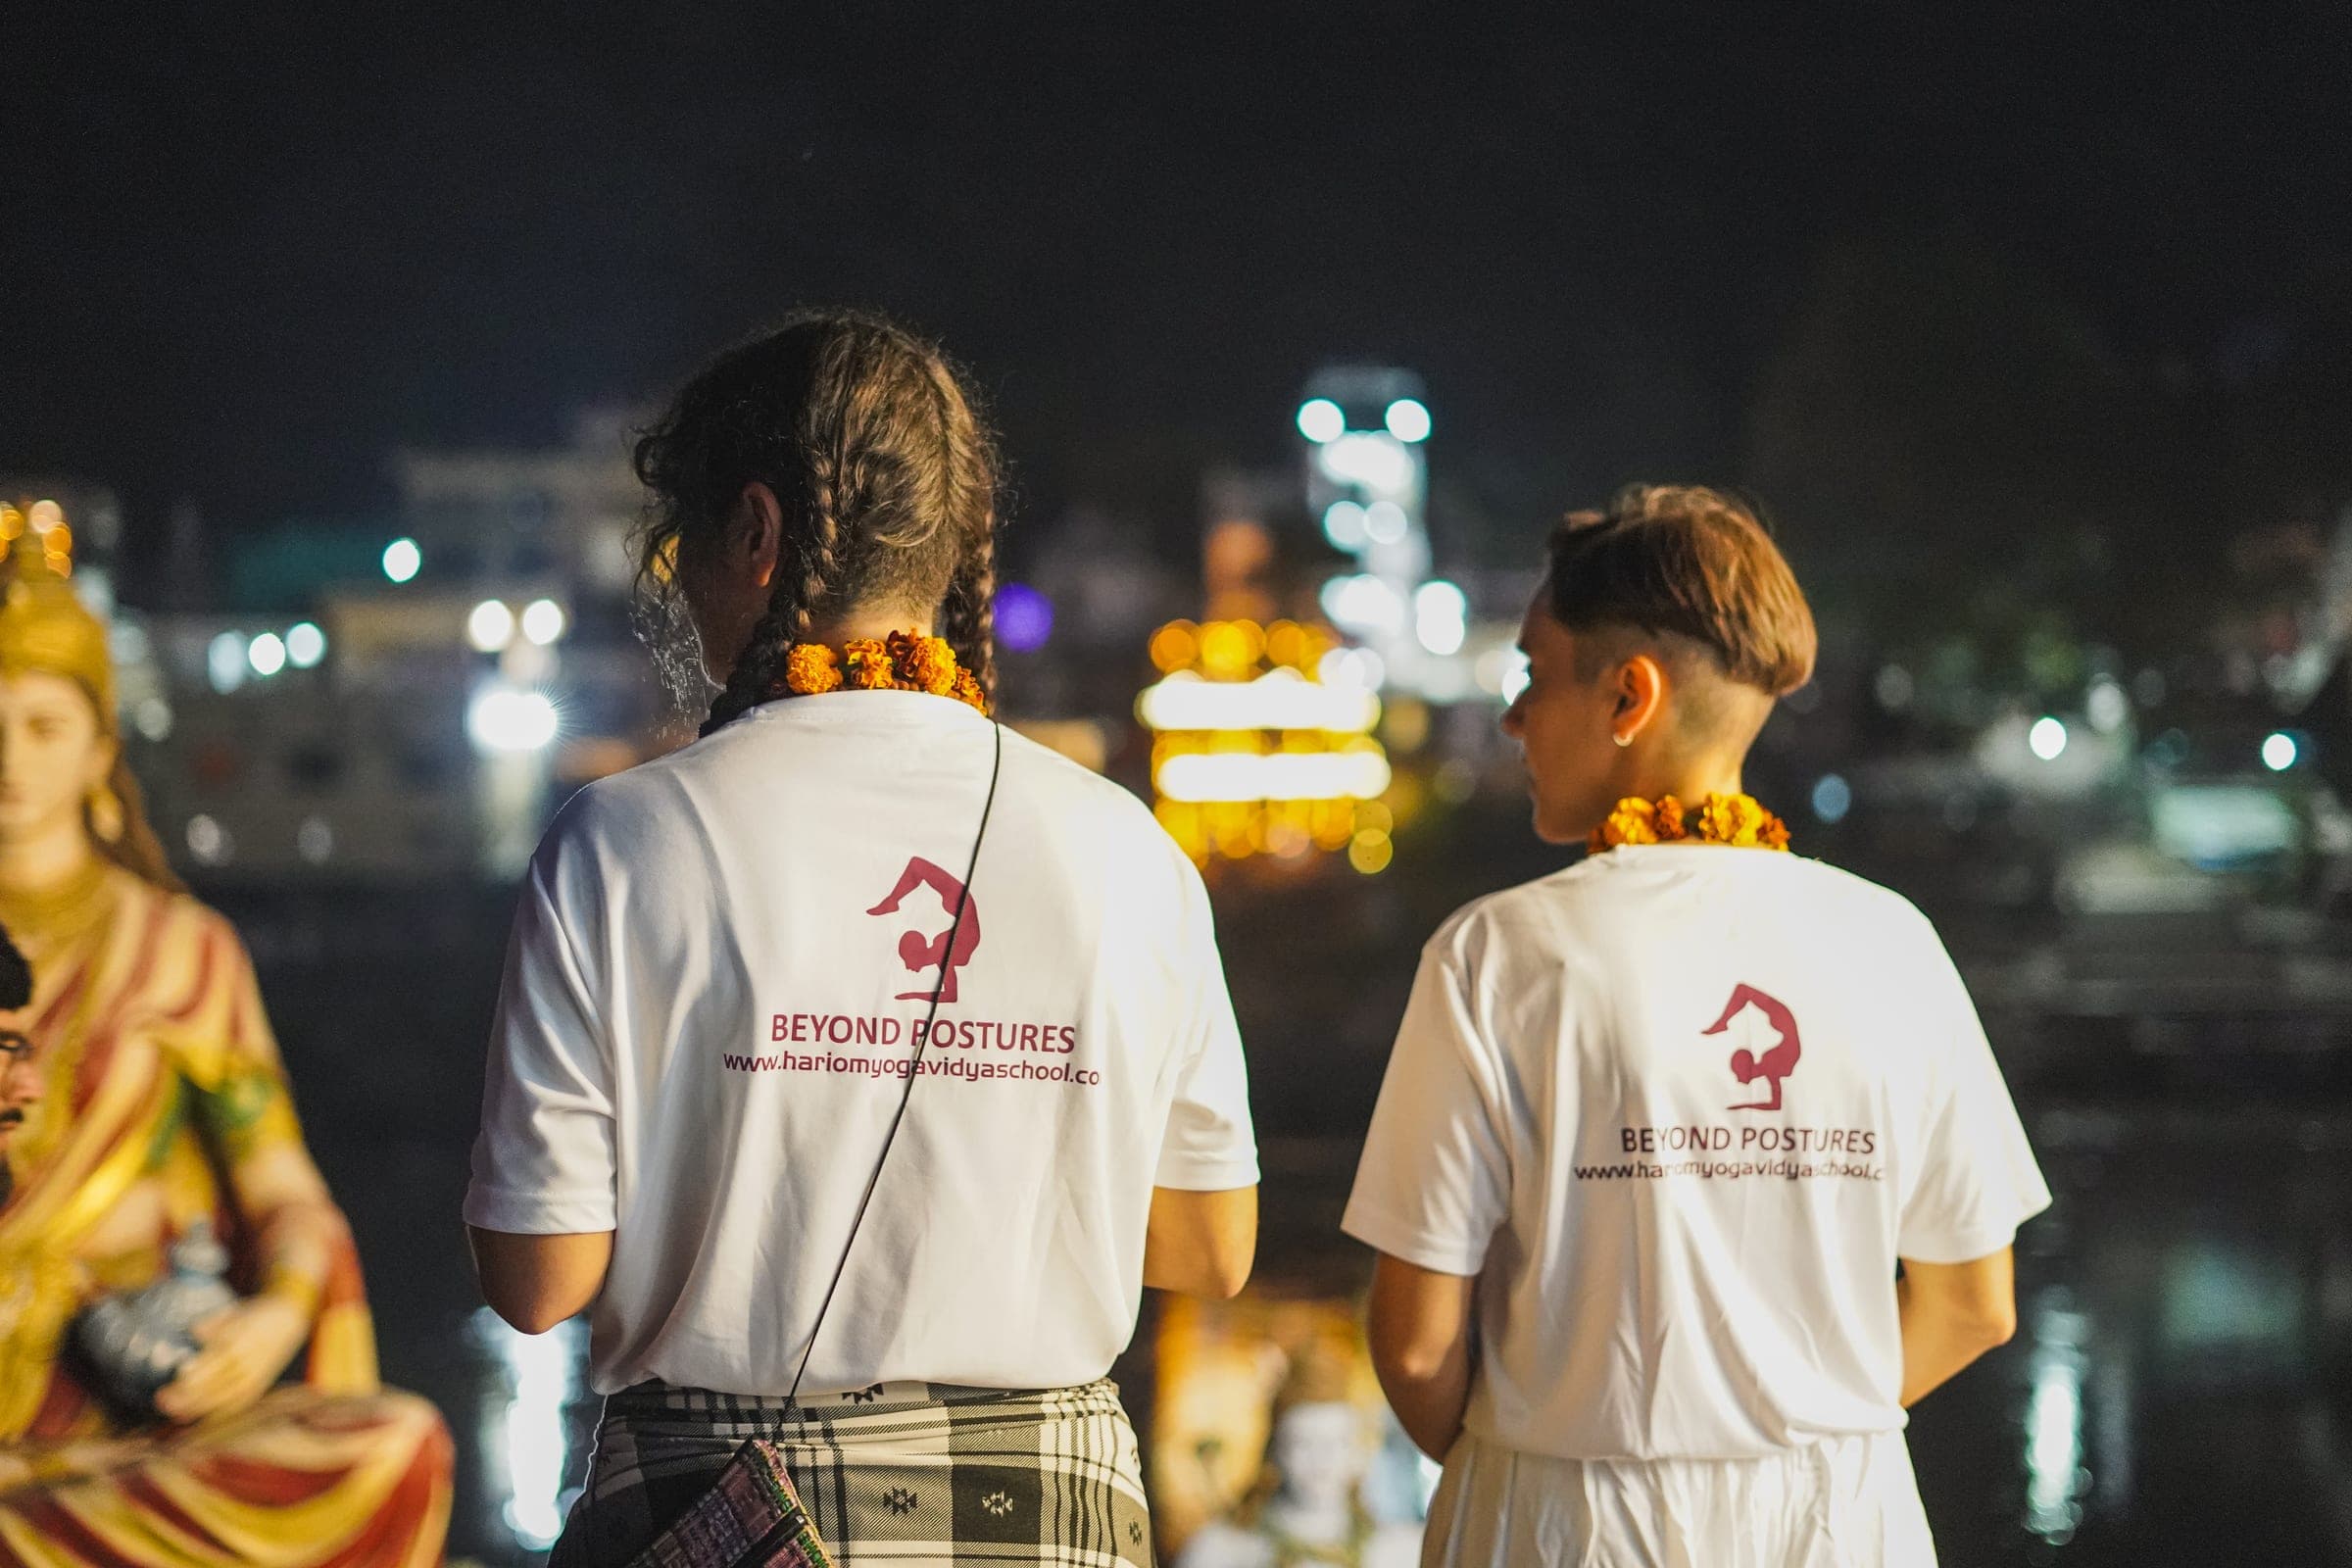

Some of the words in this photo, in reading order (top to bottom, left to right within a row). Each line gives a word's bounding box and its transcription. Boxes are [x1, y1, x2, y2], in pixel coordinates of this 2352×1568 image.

[770, 1013, 902, 1046] BEYOND
[910, 1018, 1076, 1054] POSTURES
[722, 1051, 1101, 1086] www.hariomyogavidyaschool.co
[1620, 1126, 1732, 1152] BEYOND
[1740, 1127, 1876, 1154] POSTURES
